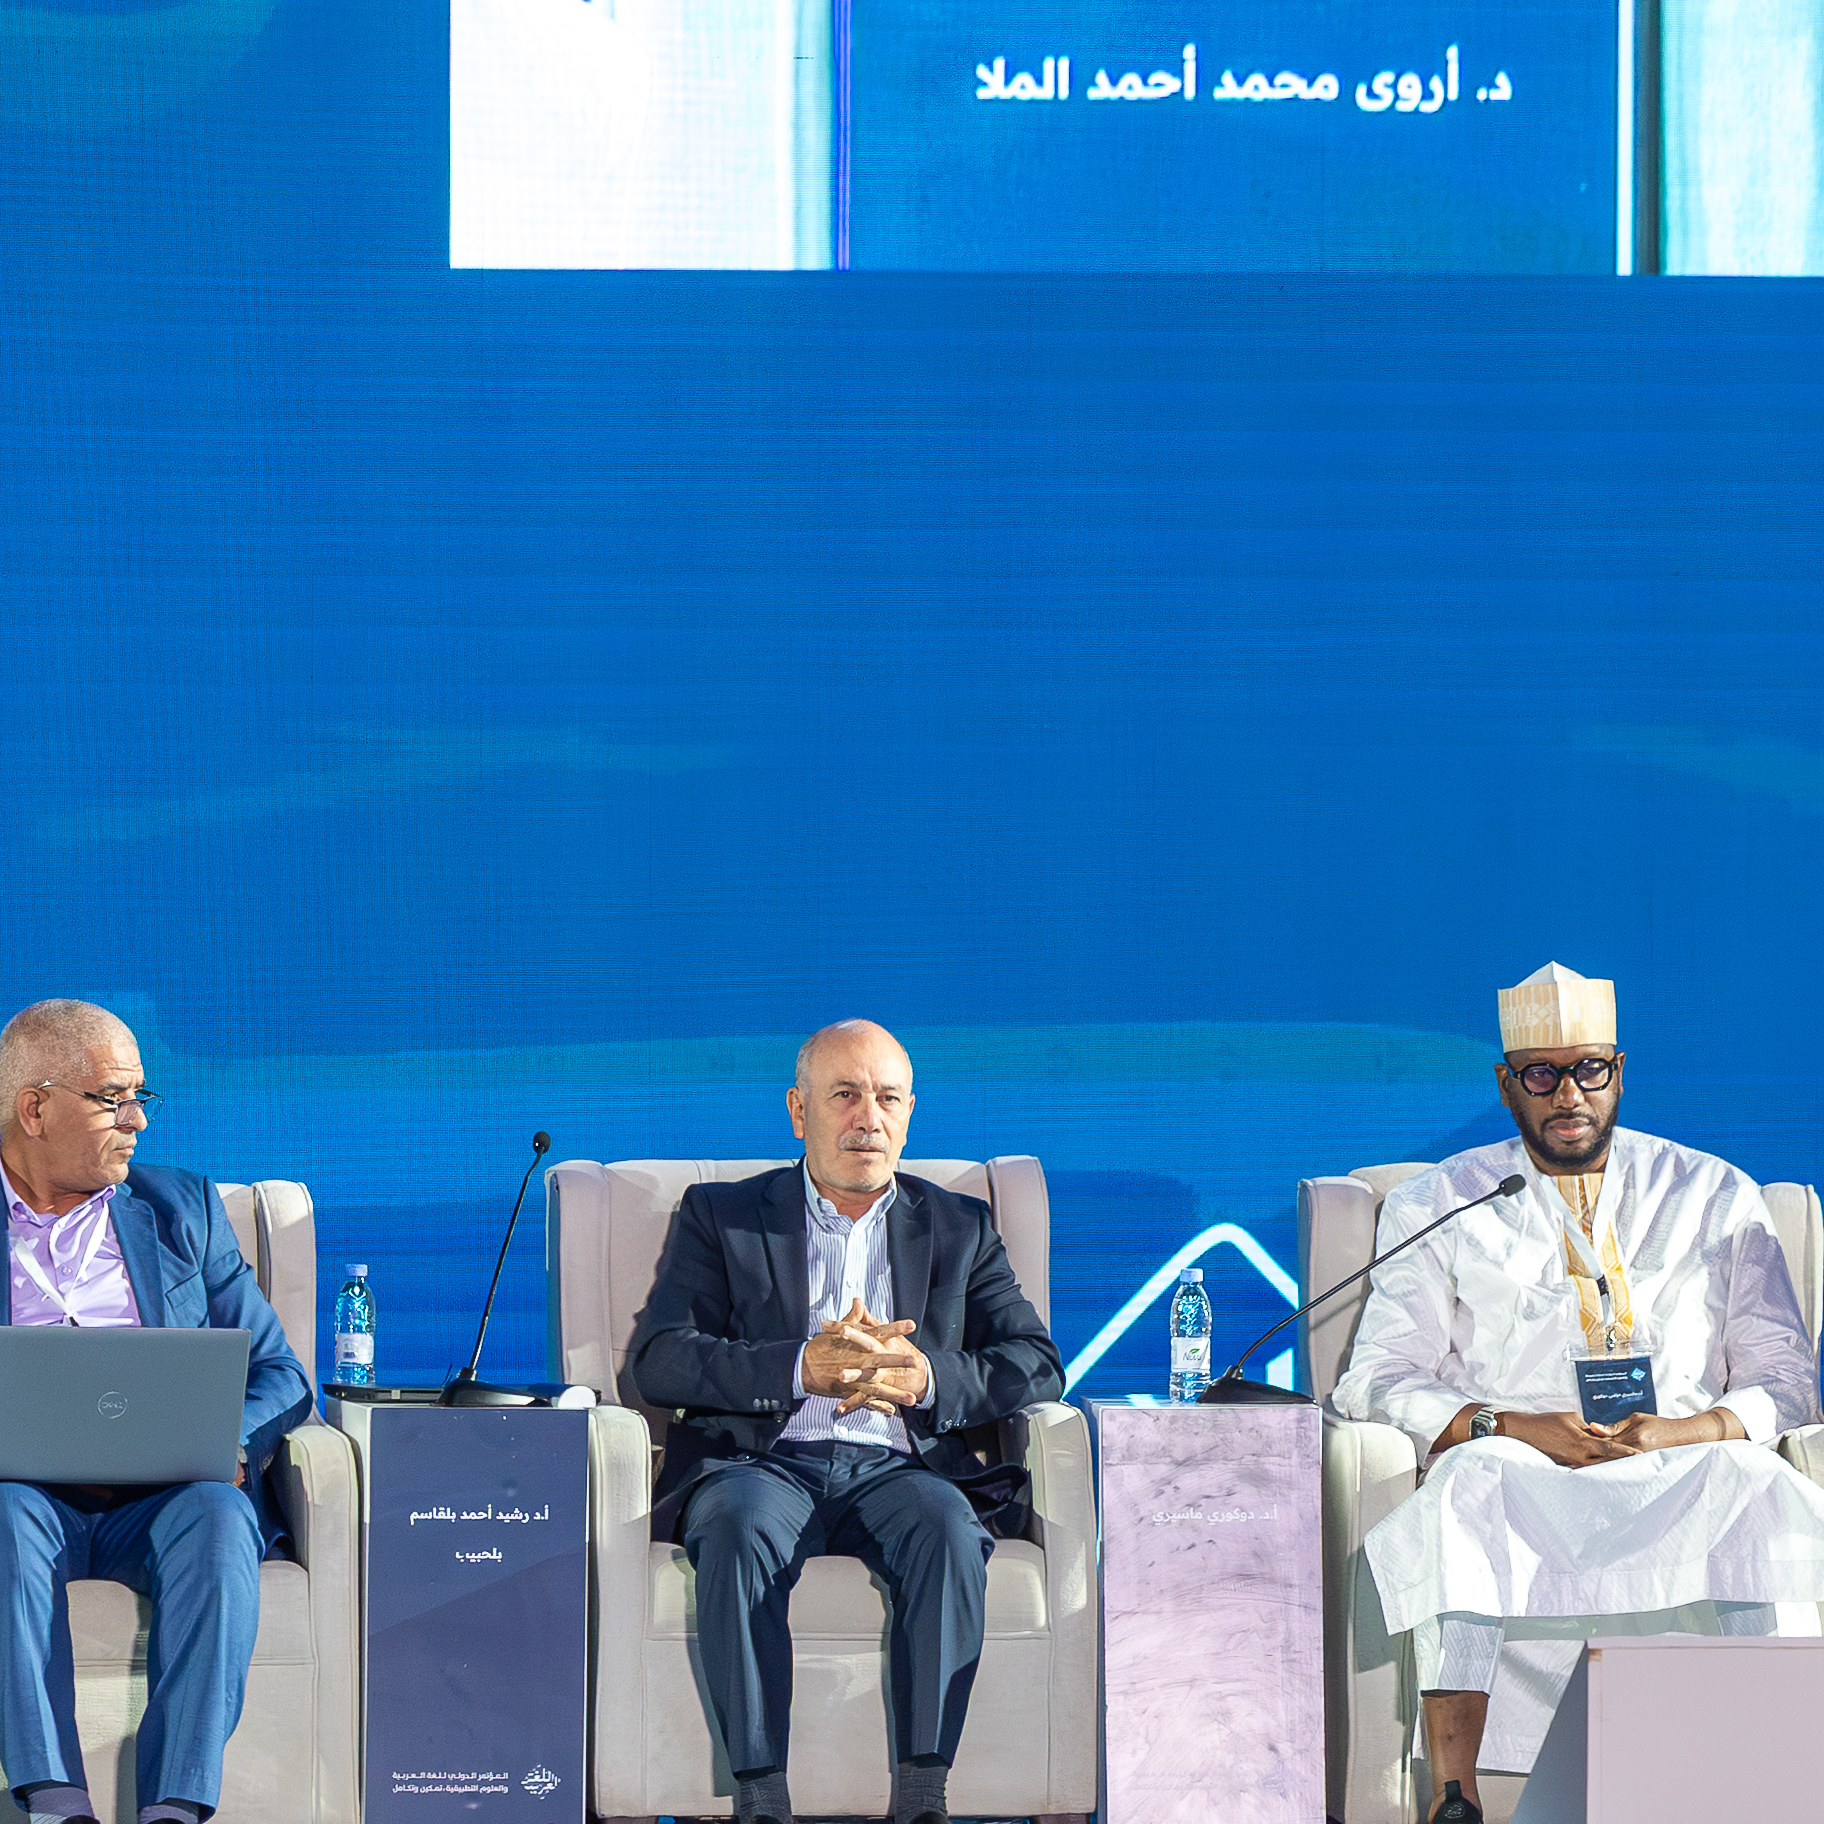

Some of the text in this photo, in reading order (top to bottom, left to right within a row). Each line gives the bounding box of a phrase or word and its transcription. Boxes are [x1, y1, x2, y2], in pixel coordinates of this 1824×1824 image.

[975, 43, 1512, 113] د. أروى محمد أحمد الملا
[409, 1506, 457, 1526] بلقاسم
[459, 1503, 492, 1520] أحمد
[495, 1506, 530, 1524] رشيد
[1152, 1507, 1204, 1526] ماسيري
[1207, 1507, 1255, 1526] دوكوري
[455, 1547, 503, 1563] بلحبيب
